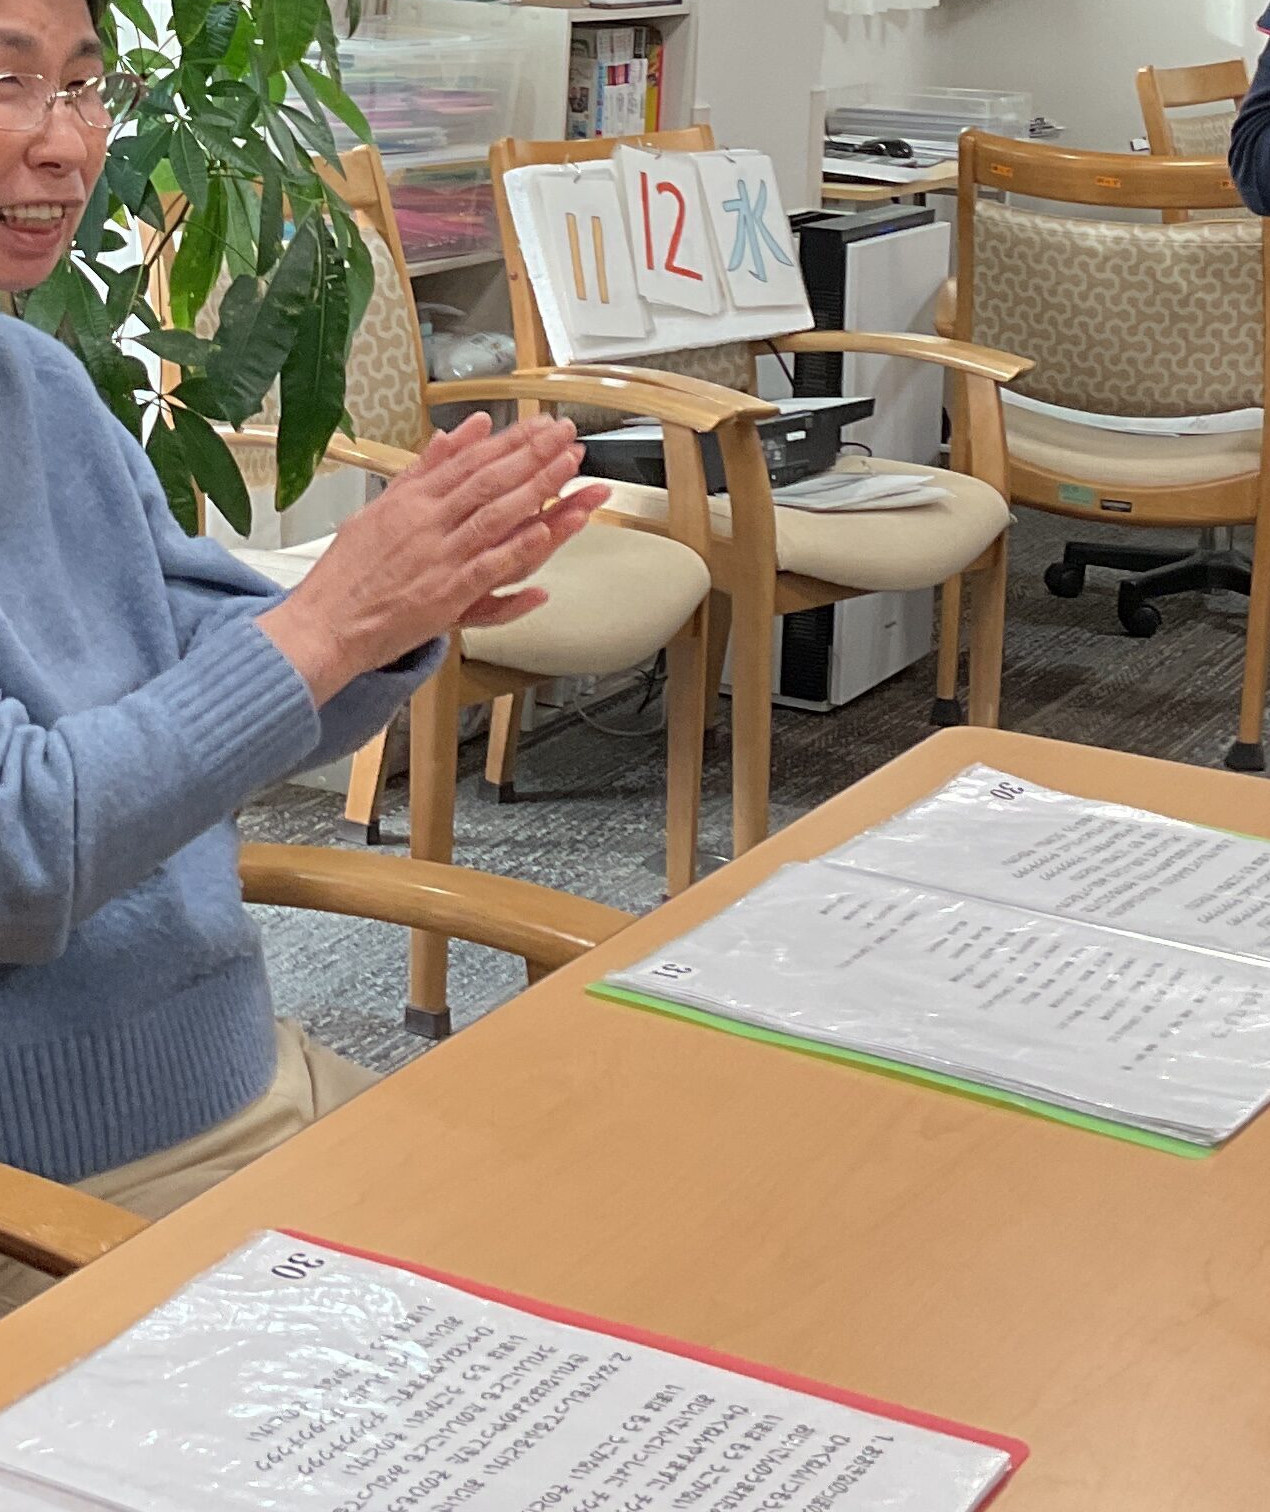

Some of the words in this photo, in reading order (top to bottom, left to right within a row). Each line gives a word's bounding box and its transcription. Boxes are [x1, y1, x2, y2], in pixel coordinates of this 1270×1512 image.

[565, 212, 610, 305] 11
[640, 171, 704, 281] 12
[722, 178, 794, 283] 水
[990, 781, 1024, 800] 30
[651, 963, 693, 979] 31
[271, 1252, 325, 1280] 30
[528, 1484, 574, 1512] そのと
[615, 1493, 653, 1512] チク
